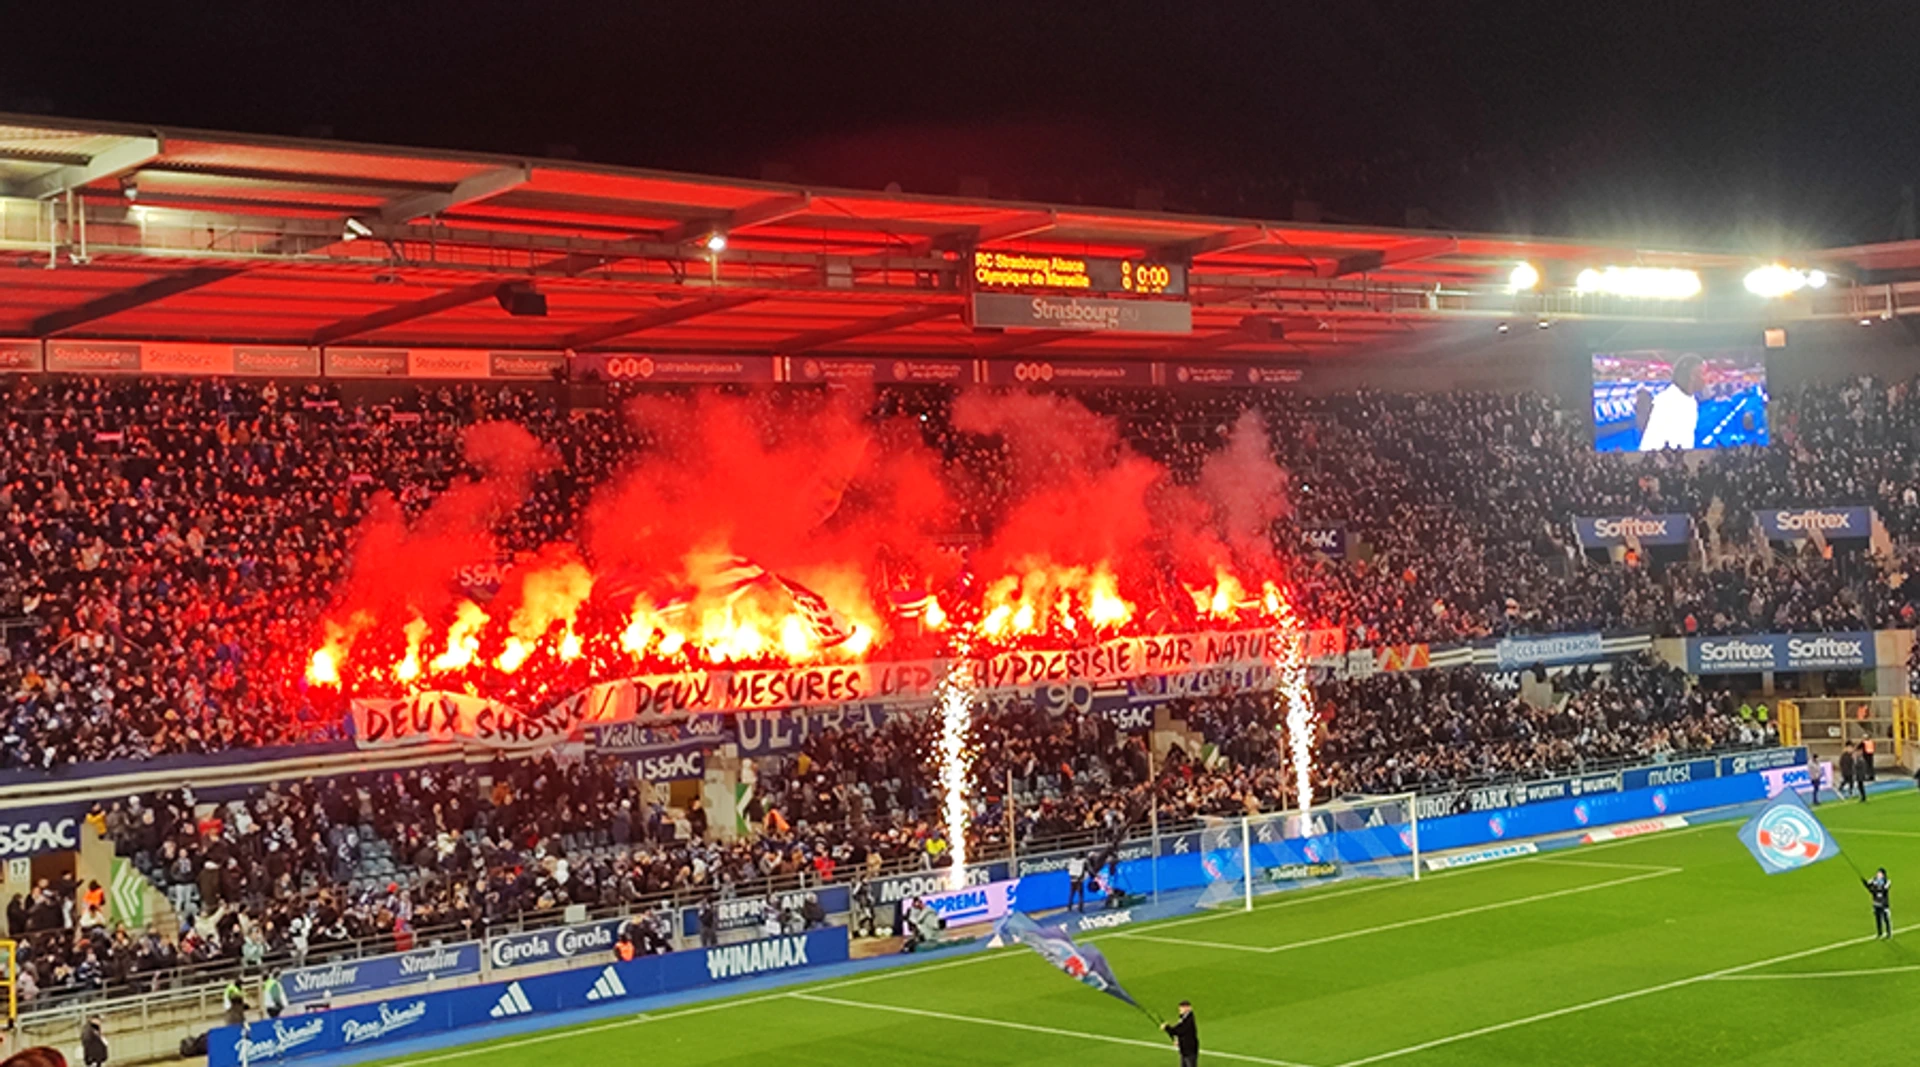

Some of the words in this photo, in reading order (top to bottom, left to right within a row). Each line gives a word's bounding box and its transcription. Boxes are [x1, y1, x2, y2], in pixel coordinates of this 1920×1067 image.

[975, 252, 993, 268] RC
[995, 253, 1049, 275] Strasbourg
[1051, 256, 1085, 272] Alsace
[976, 268, 1030, 287] Olympique
[1031, 271, 1044, 285] de
[1046, 272, 1090, 288] Marseille
[1136, 265, 1169, 287] 0:00
[1594, 518, 1667, 537] Sofitex
[1776, 510, 1850, 530] Sofitex
[1700, 640, 1774, 661] Sofitex
[1788, 637, 1862, 658] Sofitex
[367, 697, 457, 742] DEUX
[634, 679, 711, 714] DEUX
[727, 669, 861, 707] MESURES
[881, 666, 932, 696] LFP
[973, 643, 1130, 687] HYPOCRISIE
[1145, 635, 1193, 664] PAR
[1205, 632, 1292, 661] NATUR
[1048, 682, 1092, 716] 90
[637, 751, 701, 780] ISSAC
[1472, 789, 1508, 812] PARK
[881, 868, 990, 902] McDond's
[925, 890, 988, 912] OPREMA
[492, 936, 549, 967] Carola
[555, 926, 611, 956] Carola
[707, 936, 808, 979] WINAMAX
[400, 947, 462, 975] Stradim
[294, 965, 359, 992] Stradim
